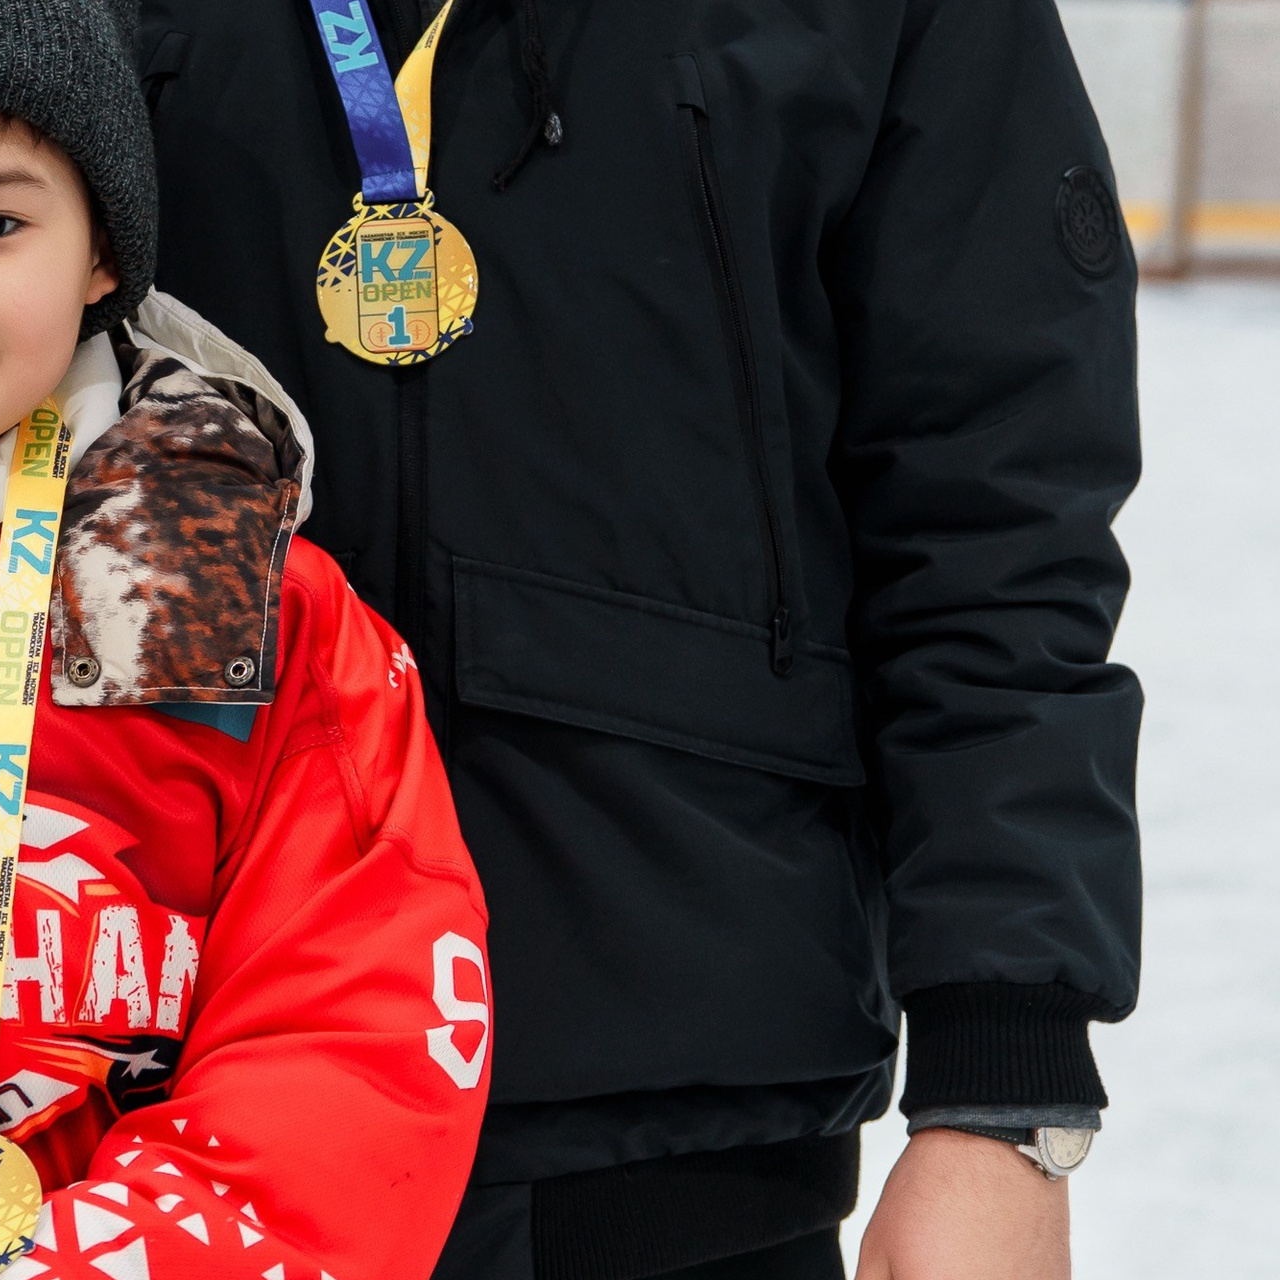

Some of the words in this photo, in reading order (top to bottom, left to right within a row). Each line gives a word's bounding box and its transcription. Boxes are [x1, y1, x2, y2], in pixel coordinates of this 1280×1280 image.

[319, 0, 380, 73] KZ
[361, 239, 431, 283] KZ
[363, 280, 433, 303] OPEN
[387, 305, 412, 347] 1
[21, 408, 59, 478] OPEN
[6, 508, 58, 575] KZ
[35, 611, 46, 658] KAZAKHSTAN
[28, 677, 37, 707] HOCKEY
[3, 856, 14, 908] KAZAKHSTAN
